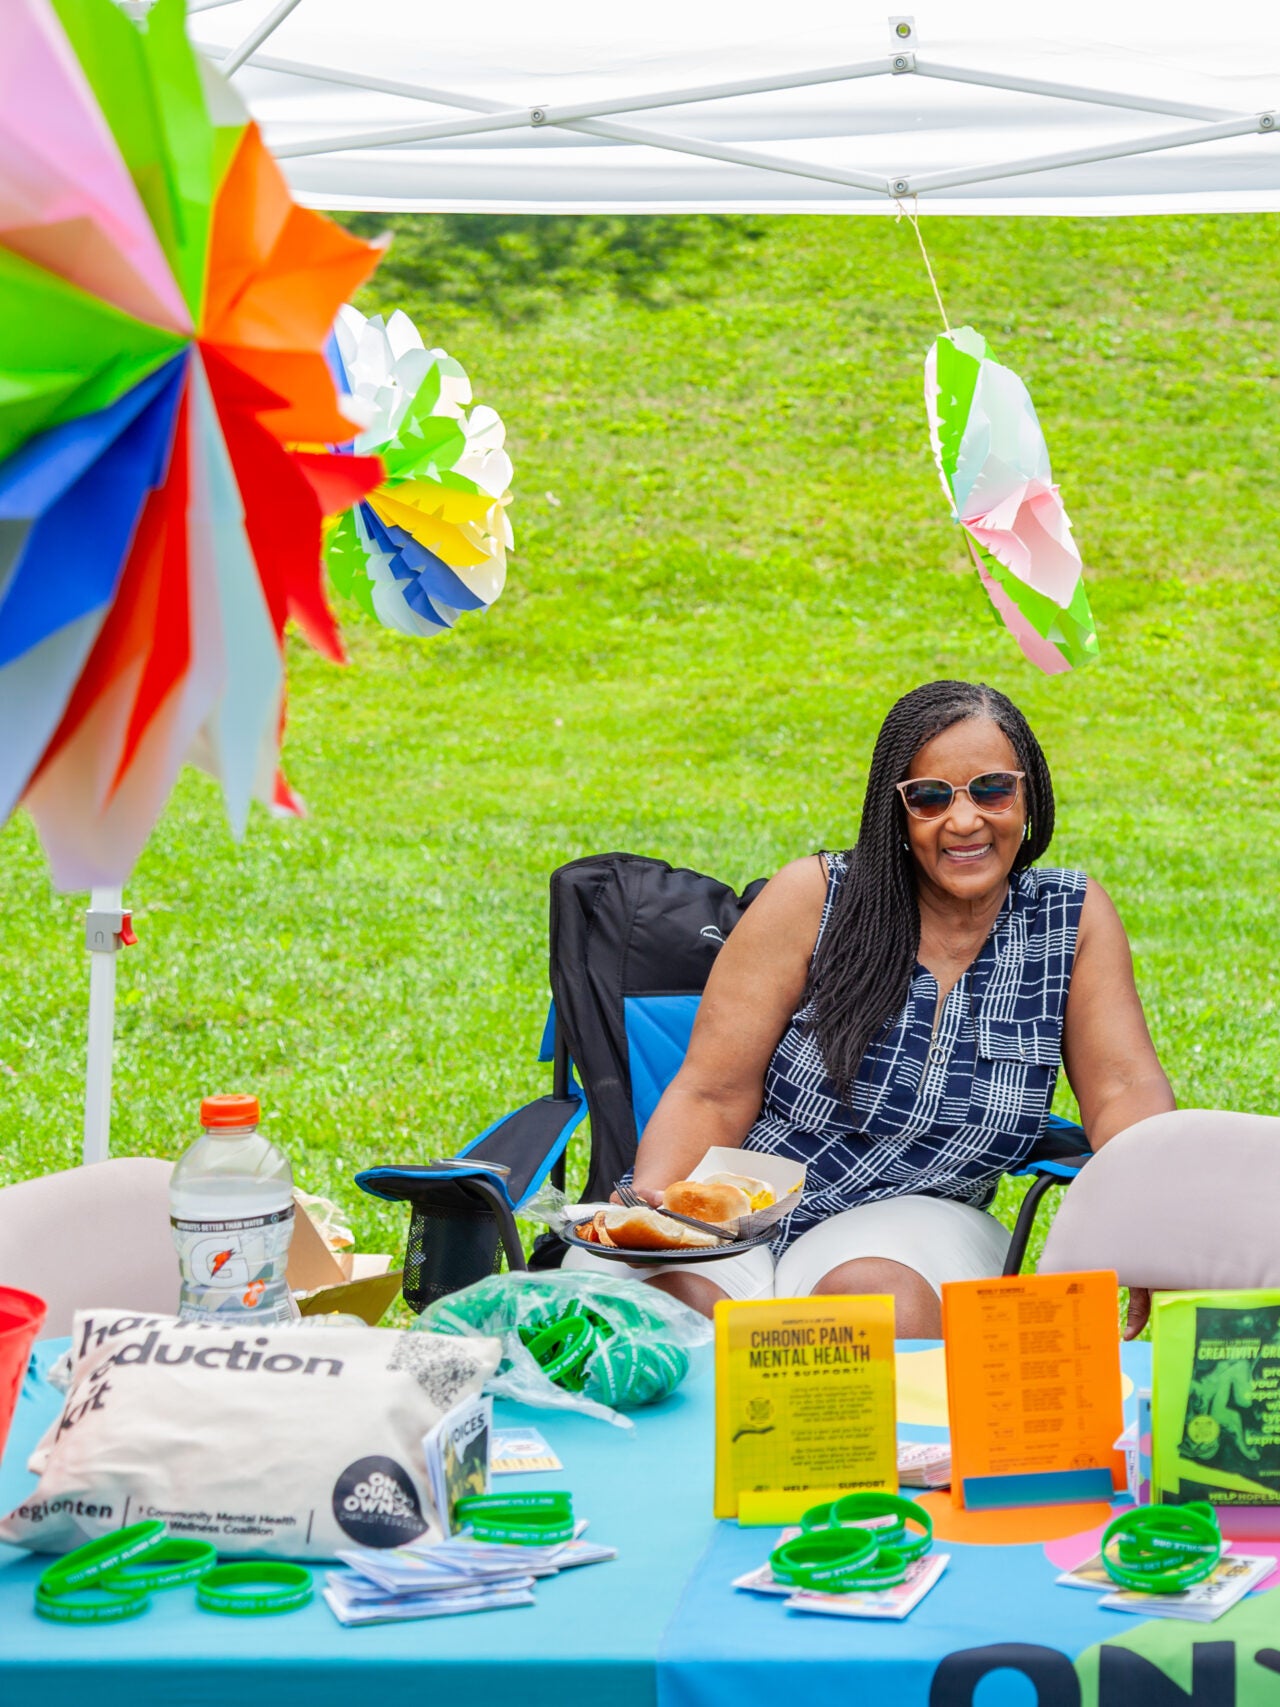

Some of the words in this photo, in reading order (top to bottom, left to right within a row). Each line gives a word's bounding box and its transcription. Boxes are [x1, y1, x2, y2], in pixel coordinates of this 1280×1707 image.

[201, 1222, 224, 1231] BETTER
[225, 1221, 242, 1229] THAN
[243, 1217, 264, 1229] WATER
[190, 1235, 249, 1288] G
[751, 1328, 816, 1349] CHRONIC
[820, 1326, 853, 1345] PAIN
[858, 1330, 866, 1338] +
[90, 1331, 344, 1382] eduction
[750, 1349, 808, 1369] MENTAL
[813, 1345, 870, 1365] HEALTH
[1197, 1344, 1261, 1361] CREATIVITY
[762, 1371, 788, 1379] GET
[793, 1367, 865, 1378] SUPPORT!
[1251, 1379, 1279, 1391] your
[368, 1471, 397, 1492] ON
[838, 1480, 885, 1489] SUPPORT
[354, 1482, 394, 1501] OUR
[1209, 1491, 1237, 1500] HELP
[343, 1494, 394, 1515] OWN
[146, 1506, 213, 1522] Community
[215, 1512, 255, 1523] Mental
[259, 1514, 297, 1526] Health
[169, 1521, 220, 1533] Wellness
[223, 1524, 274, 1536] Coalition
